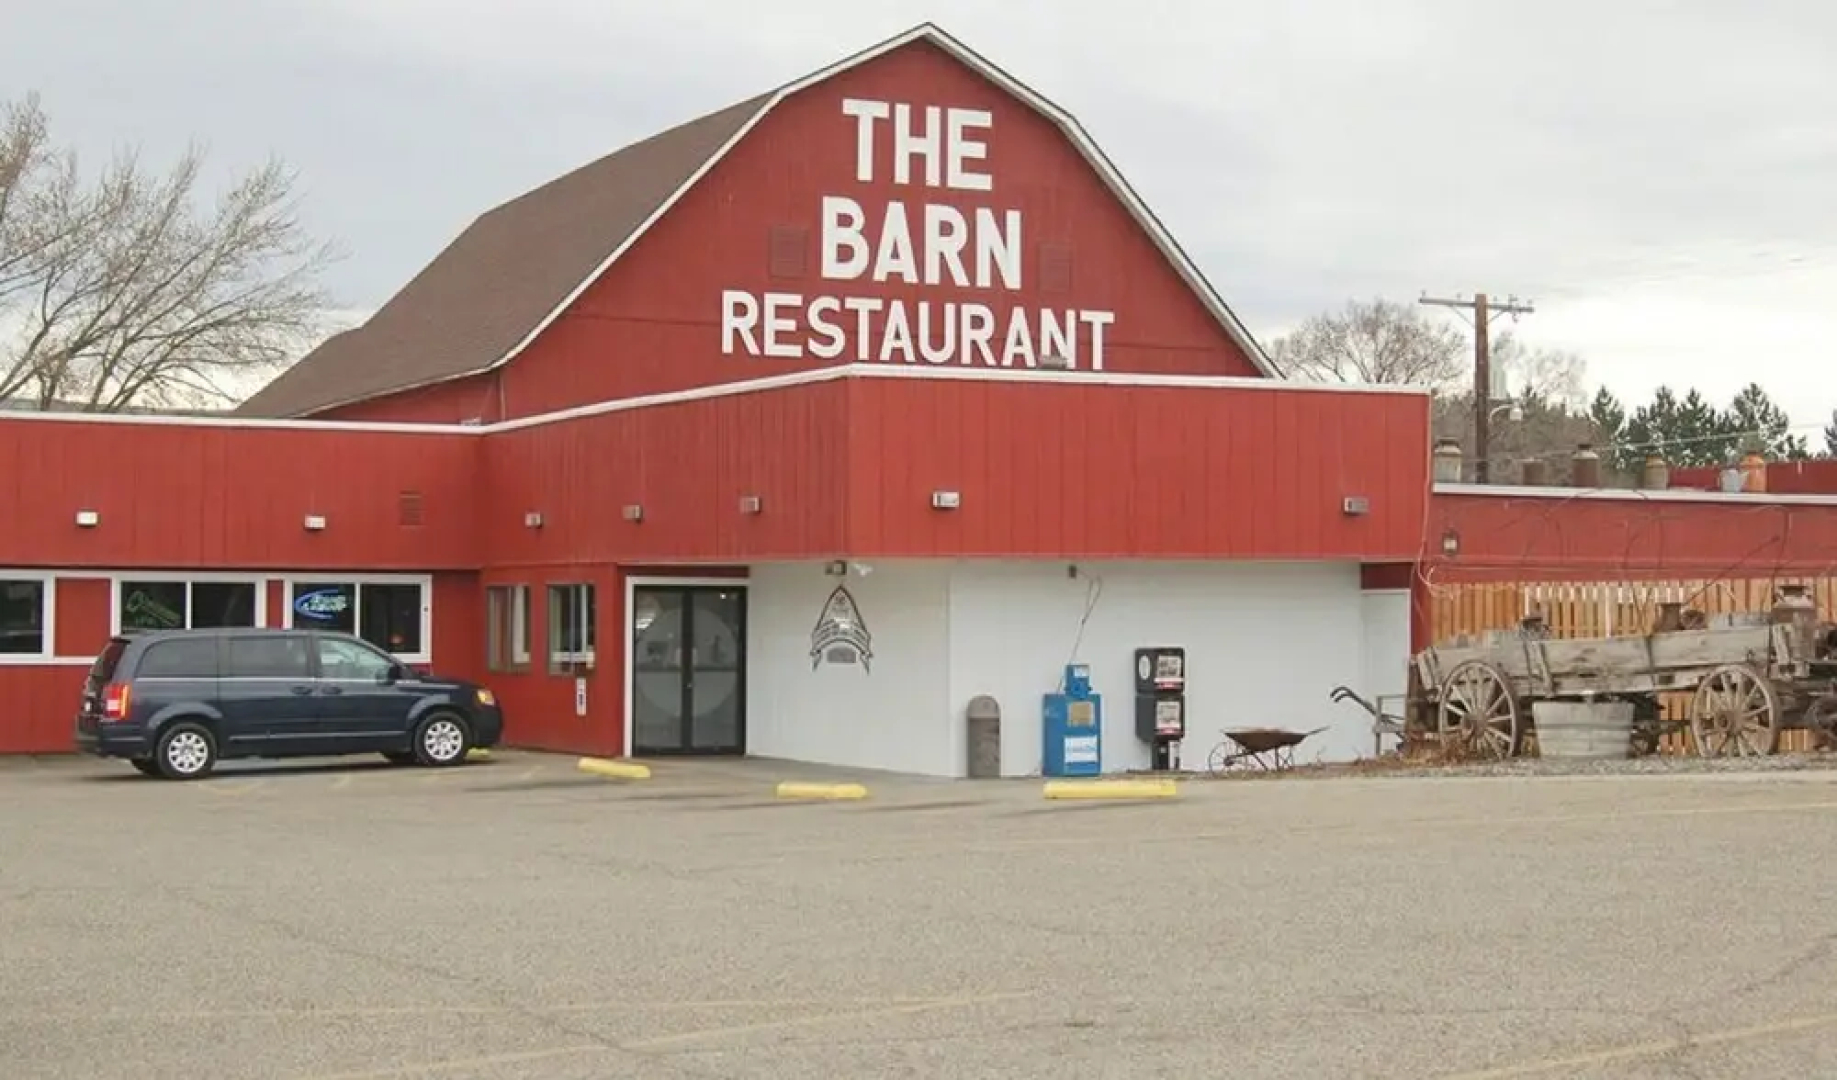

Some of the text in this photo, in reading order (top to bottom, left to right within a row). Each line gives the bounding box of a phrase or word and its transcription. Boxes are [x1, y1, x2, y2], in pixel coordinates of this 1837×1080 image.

[842, 98, 993, 191] THE
[822, 196, 1022, 290] BARN
[721, 289, 1115, 370] RESTAURANT
